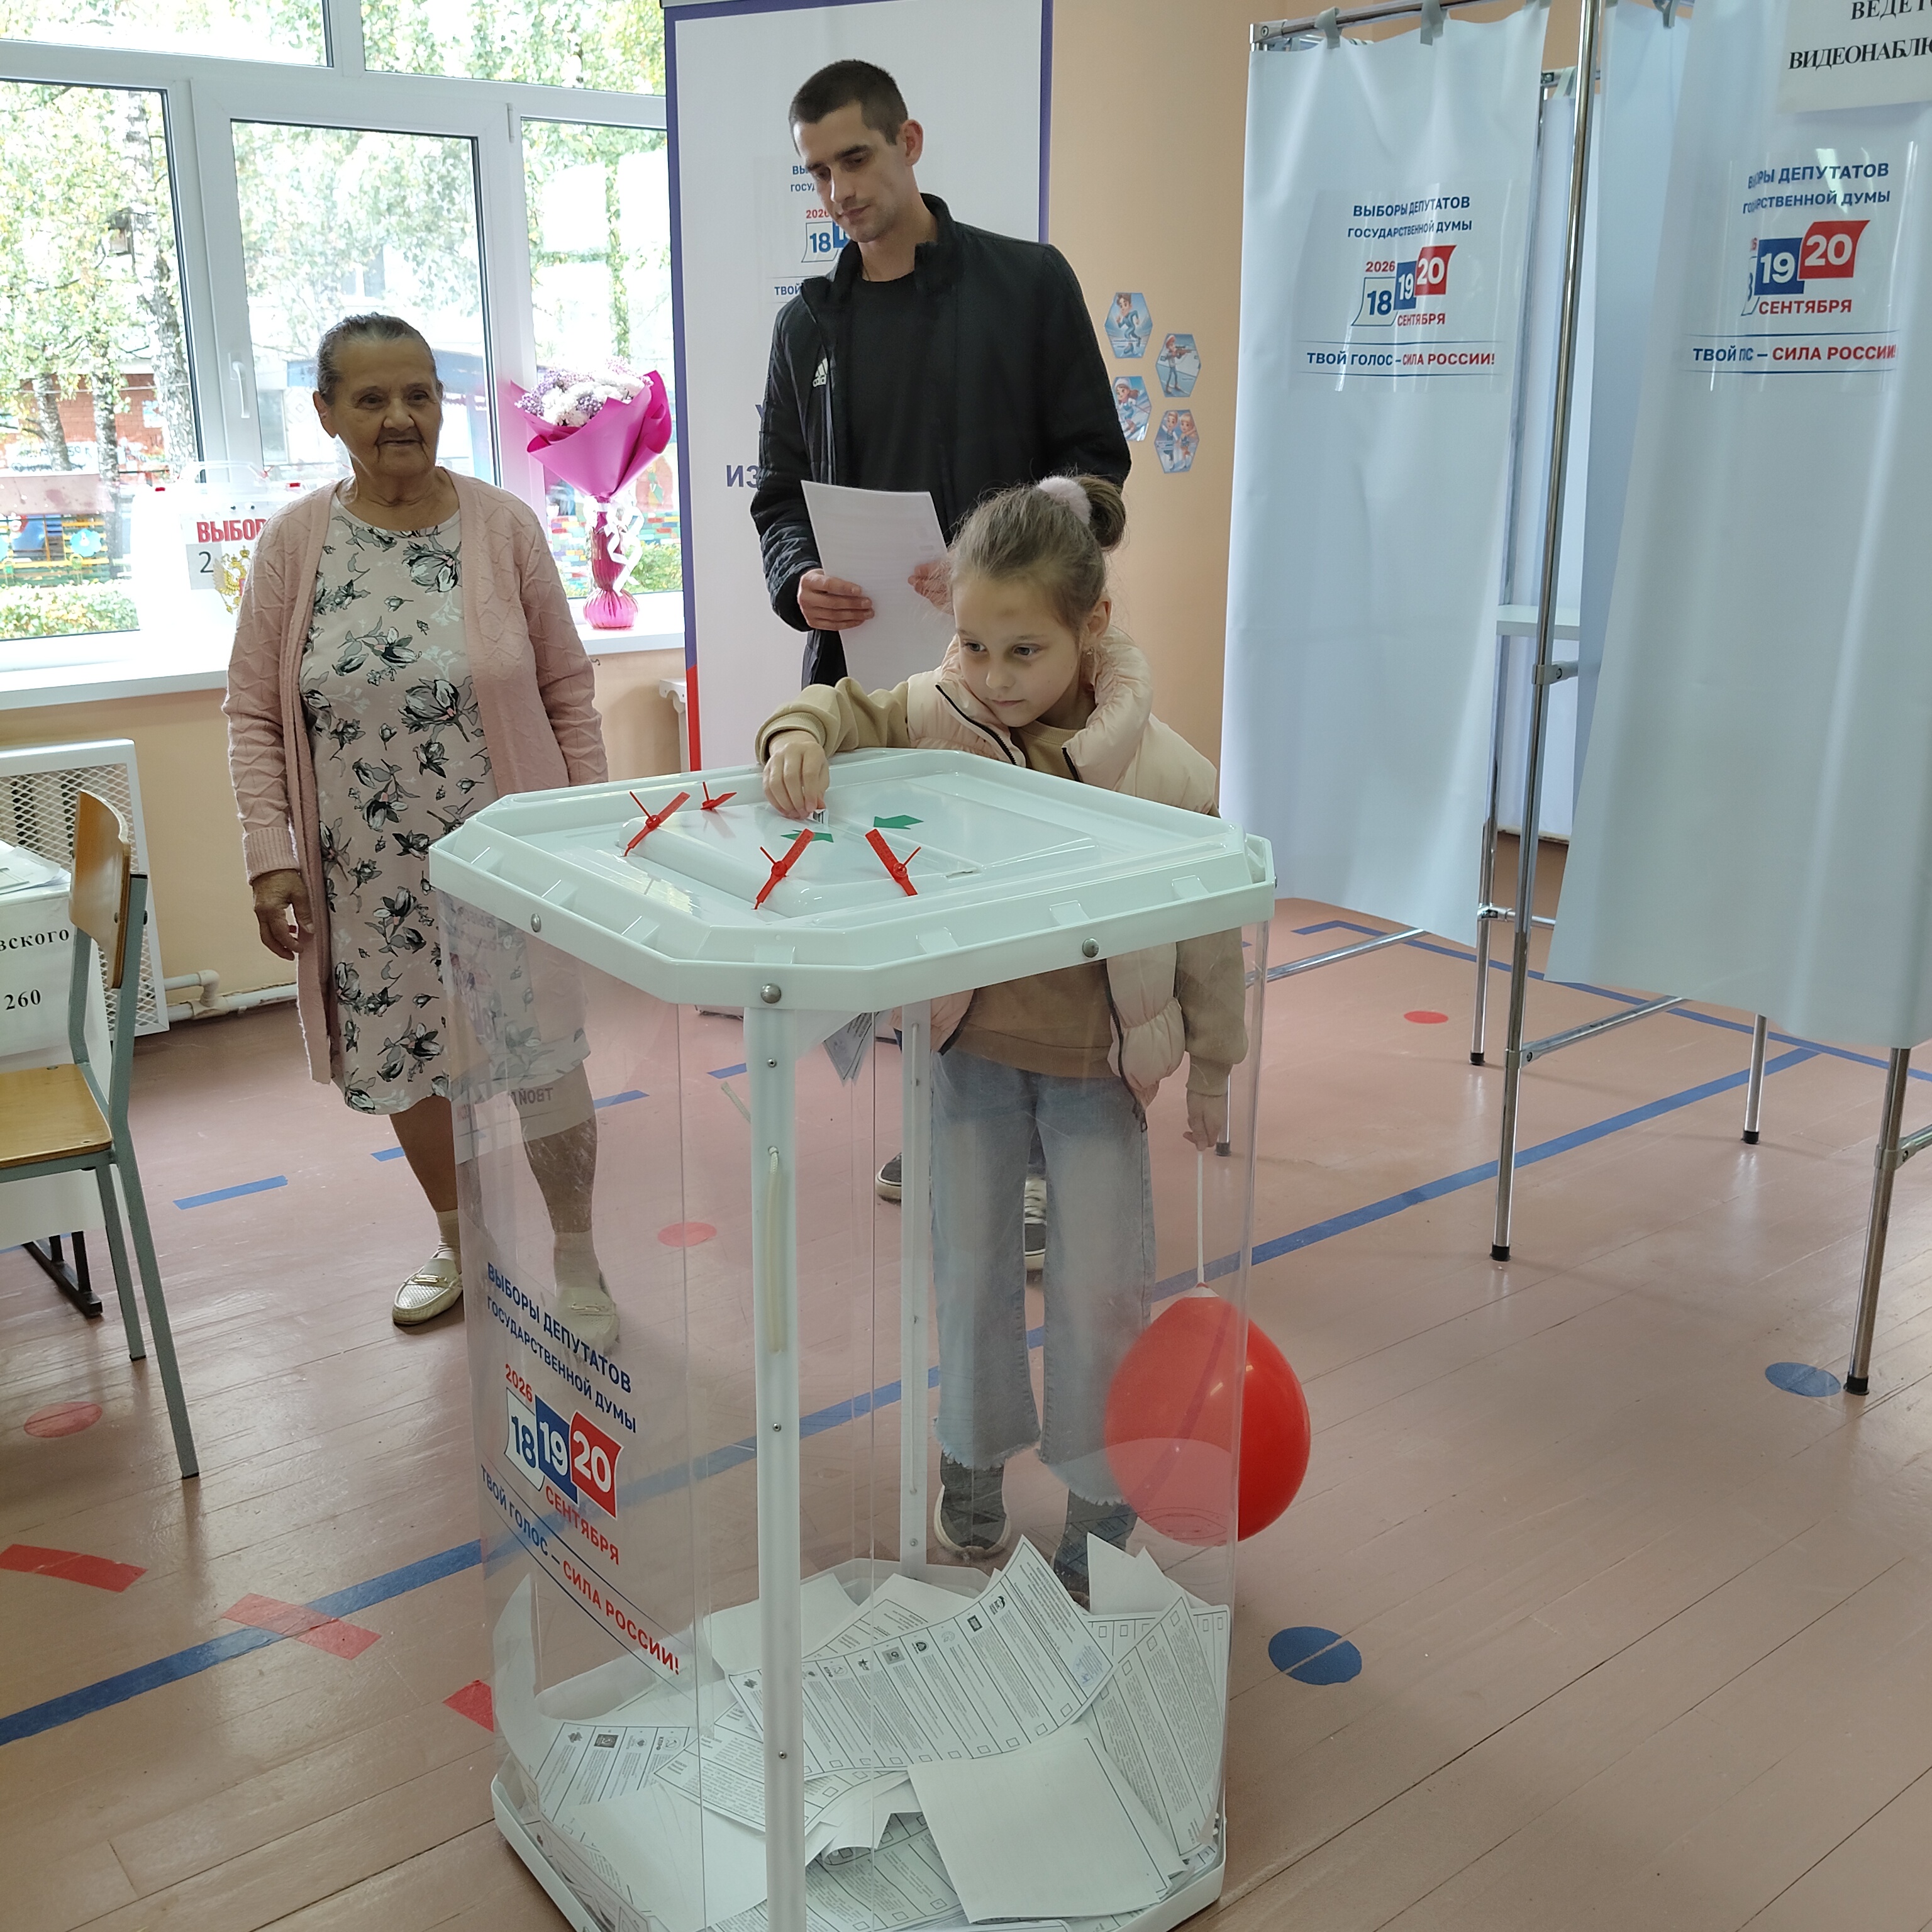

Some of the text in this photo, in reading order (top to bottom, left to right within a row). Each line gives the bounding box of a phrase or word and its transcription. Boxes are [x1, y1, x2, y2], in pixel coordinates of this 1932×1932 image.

[1850, 0, 1932, 20] ВЕДЕТ
[1778, 163, 1889, 184] ДЕПУТАТОВ
[1353, 196, 1470, 217] ВЫБОРЫ ДЕПУТАТОВ
[1841, 191, 1890, 206] ДУМЫ
[1348, 220, 1472, 240] ГОСУДАРСТВЕННОЙ ДУМЫ
[809, 232, 831, 253] 18
[1365, 261, 1396, 272] 2026
[1760, 233, 1853, 284] 19 20
[1367, 257, 1445, 316] 18 19 20
[1759, 299, 1852, 315] СЕНТЯБРЯ
[1397, 313, 1446, 327] СЕНТЯБРЯ
[1307, 350, 1346, 365] ТВОЙ
[1351, 354, 1393, 365] ГОЛОС
[1402, 354, 1424, 365] СИЛА
[1428, 353, 1495, 365] РОССИИ!
[1693, 345, 1736, 362] ТВОЙ
[1772, 347, 1821, 361] СИЛА
[1827, 344, 1897, 361] РОССИИ!
[4, 989, 41, 1010] 260
[488, 1262, 631, 1393] ВЫБОРЫ ДЕПУТАТОВ
[487, 1296, 636, 1433] ГОСУДАРСТВЕННОЙ ДУМЫ
[506, 1363, 533, 1402] 2026
[511, 1416, 611, 1493] 18 19 20
[546, 1485, 619, 1565] СЕНТЯБРЯ
[481, 1463, 506, 1511] ТВОЙ
[510, 1502, 548, 1556] ГОЛОС
[564, 1560, 602, 1610] СИЛА
[606, 1599, 679, 1675] РОССИИ!
